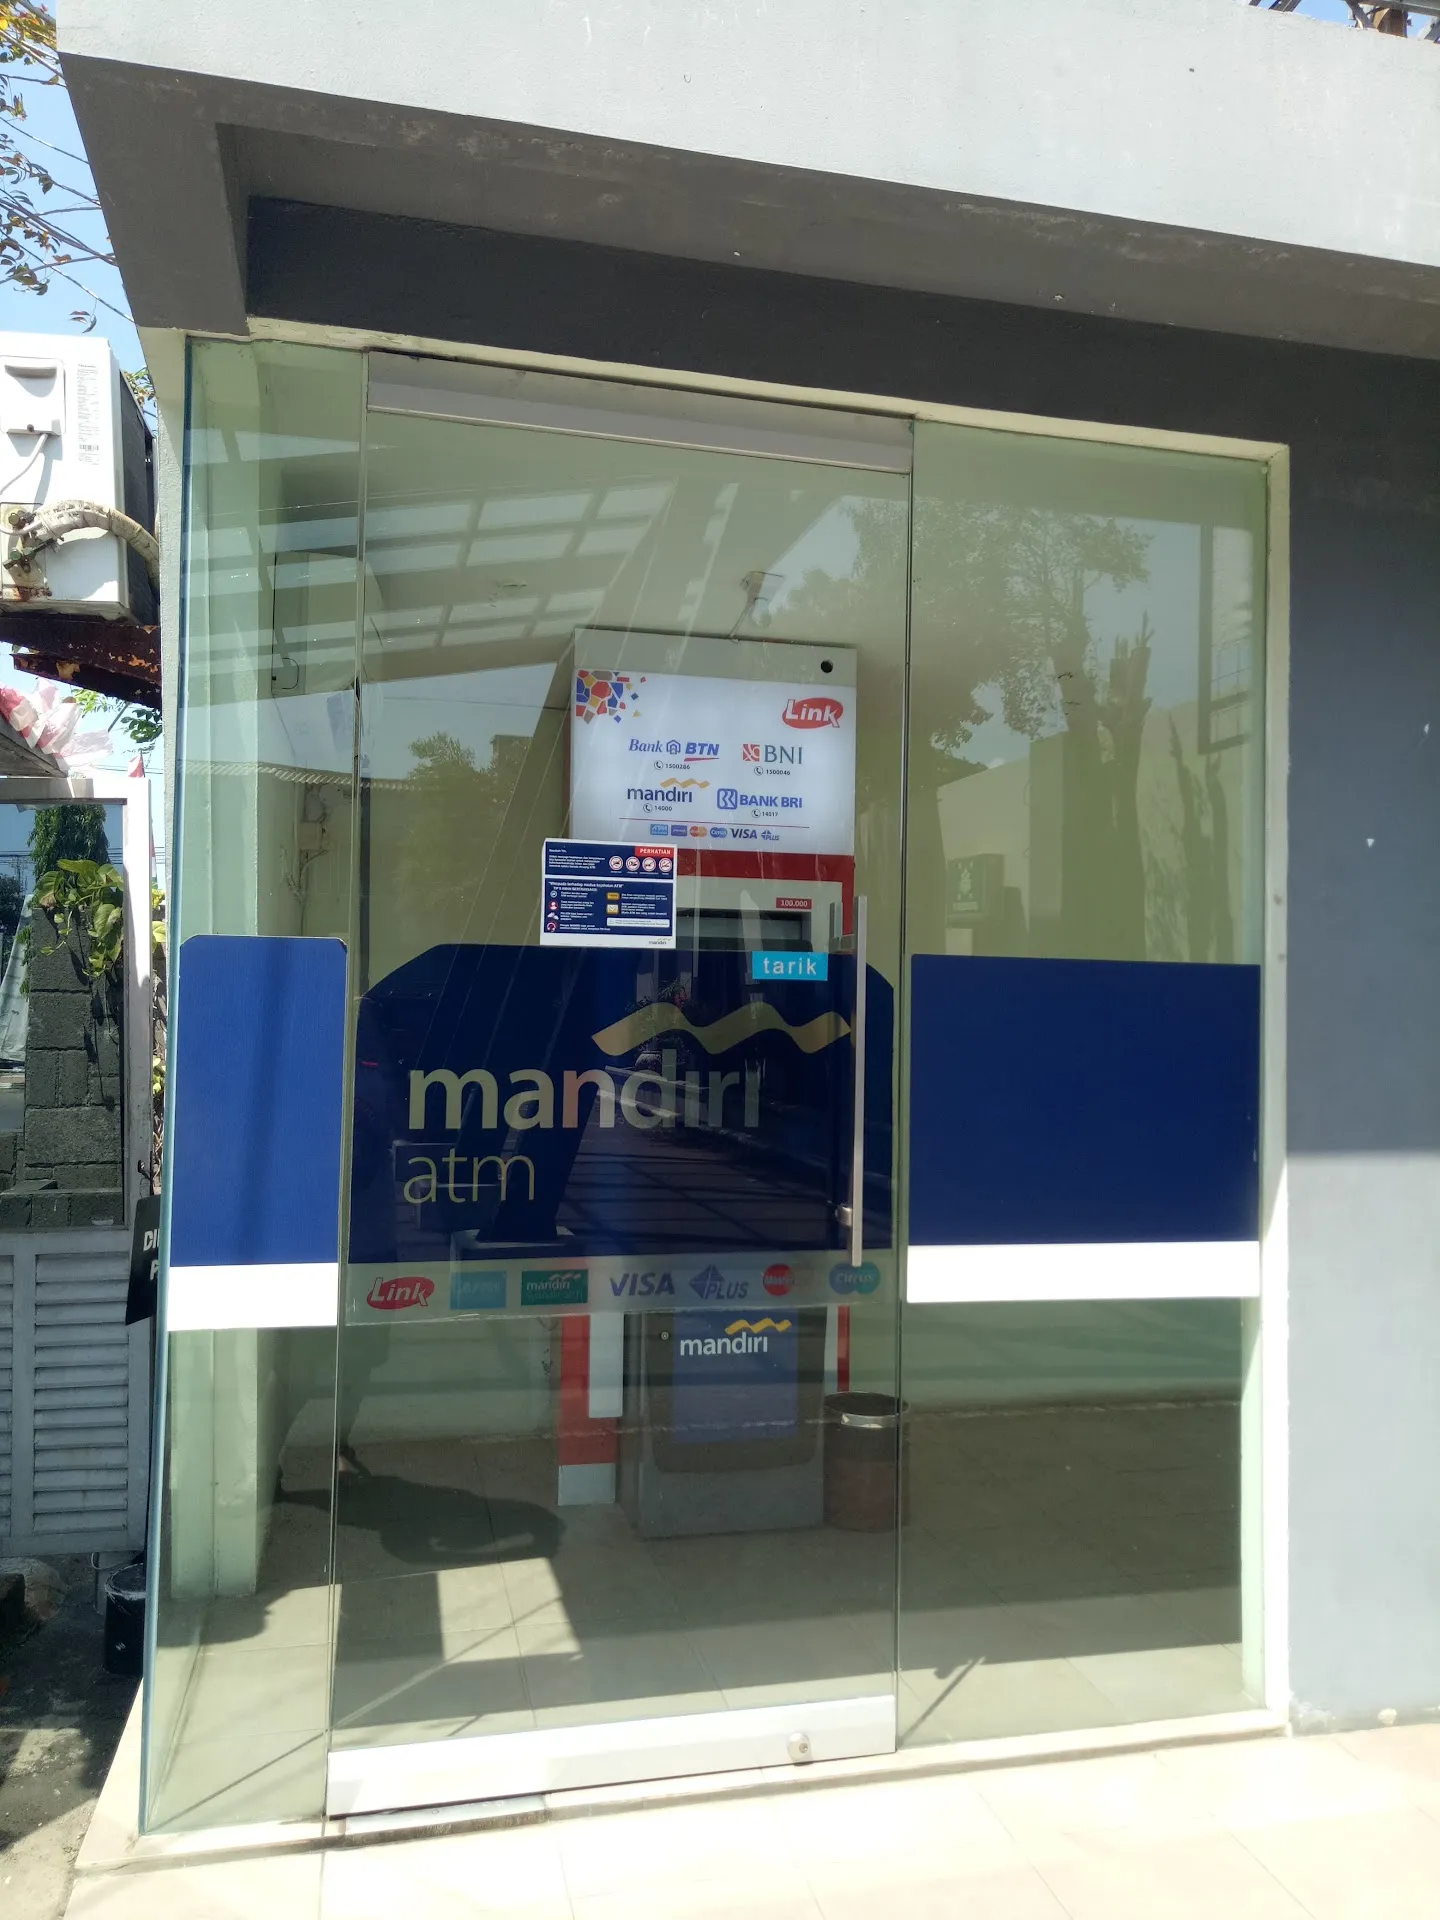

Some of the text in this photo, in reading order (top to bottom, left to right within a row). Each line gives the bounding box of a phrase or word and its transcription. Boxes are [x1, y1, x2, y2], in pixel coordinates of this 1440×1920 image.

[786, 698, 840, 729] Link
[628, 738, 720, 756] Bank BTN
[764, 744, 803, 765] BNI
[627, 787, 693, 803] mandiri
[739, 794, 803, 809] BANK BRI
[730, 828, 757, 839] VISA
[780, 899, 808, 908] 100.000
[763, 957, 817, 975] tarik
[407, 1048, 760, 1131] mandiri
[403, 1147, 535, 1205] atm
[143, 1228, 160, 1252] DI
[369, 1276, 429, 1307] Link
[526, 1279, 571, 1291] mandiri
[609, 1272, 676, 1297] VISA
[704, 1279, 749, 1300] PLUS
[679, 1331, 768, 1356] mandiri
